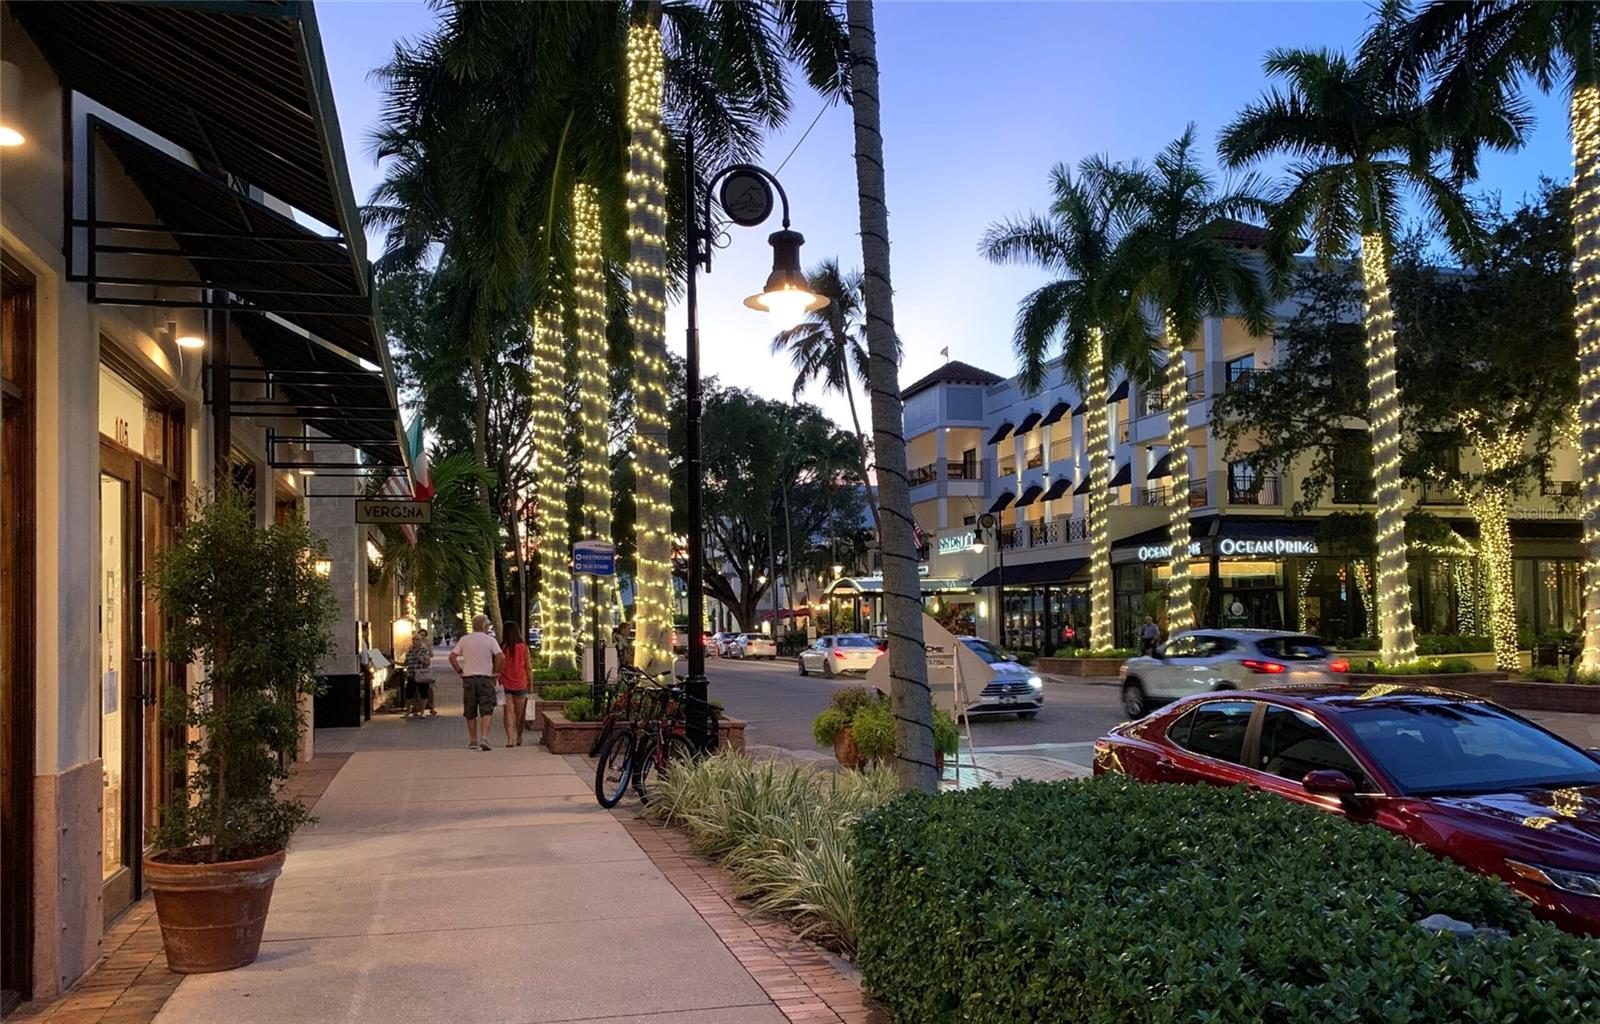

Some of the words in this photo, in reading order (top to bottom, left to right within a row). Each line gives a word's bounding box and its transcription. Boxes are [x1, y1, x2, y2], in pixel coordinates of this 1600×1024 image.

[115, 416, 128, 447] 105
[364, 505, 425, 519] VERGINA
[1138, 545, 1172, 561] OCEAN
[1220, 538, 1274, 555] OCEAN
